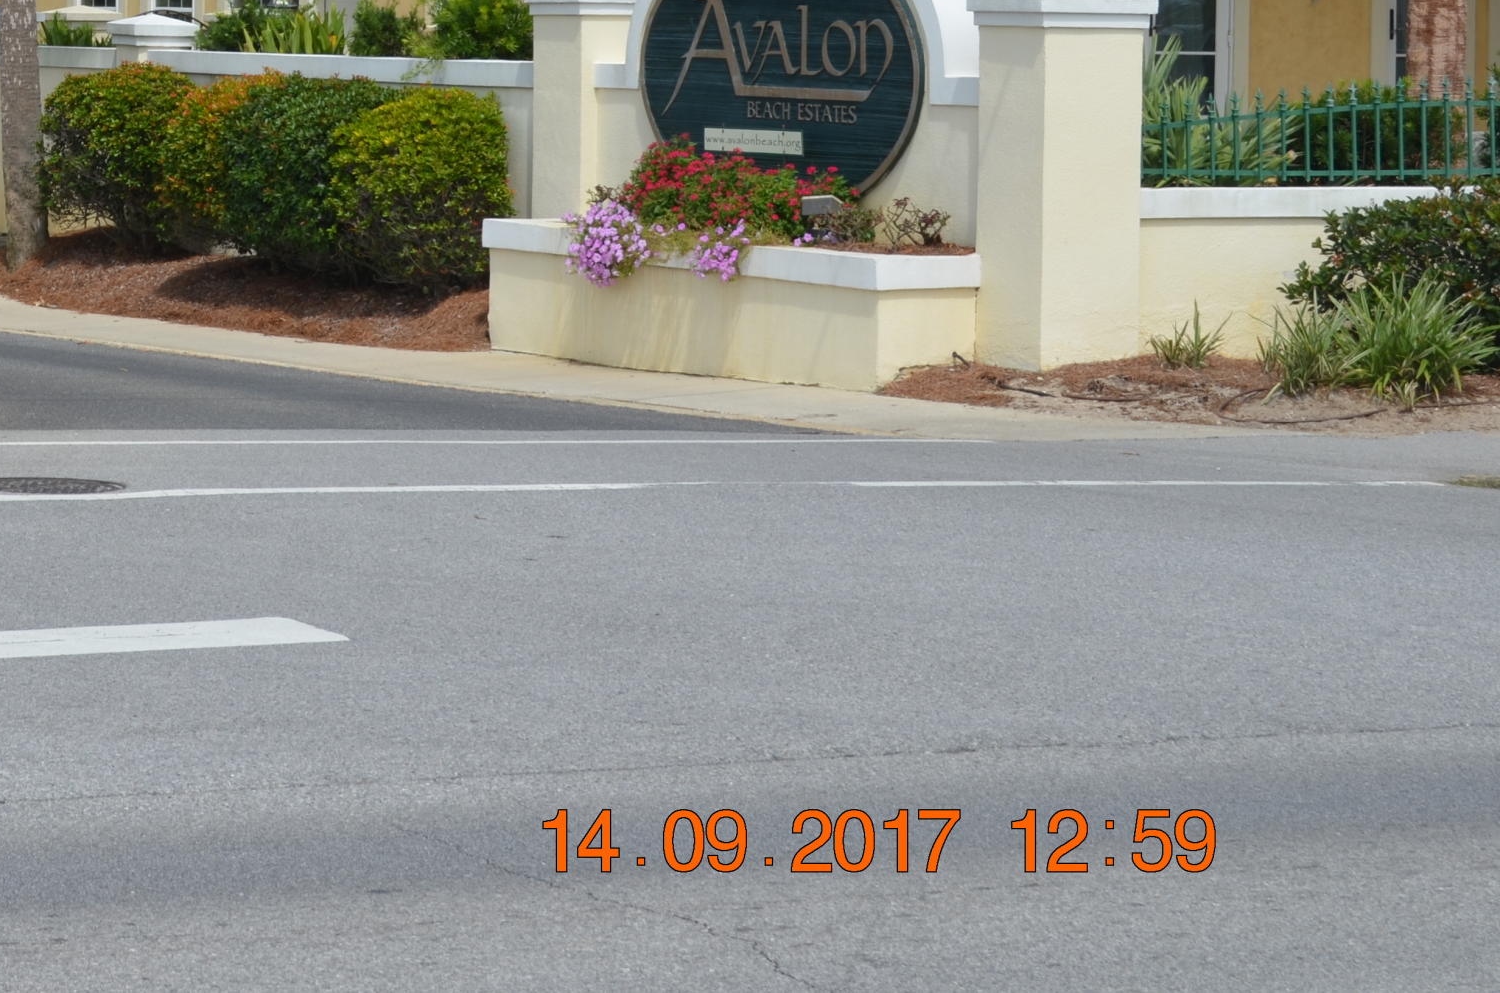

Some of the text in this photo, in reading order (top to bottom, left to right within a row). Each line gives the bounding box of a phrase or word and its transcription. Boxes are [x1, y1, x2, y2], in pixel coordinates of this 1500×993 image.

[746, 100, 858, 124] BEACH ESTATES
[705, 133, 801, 151] www.avalonbeach.org
